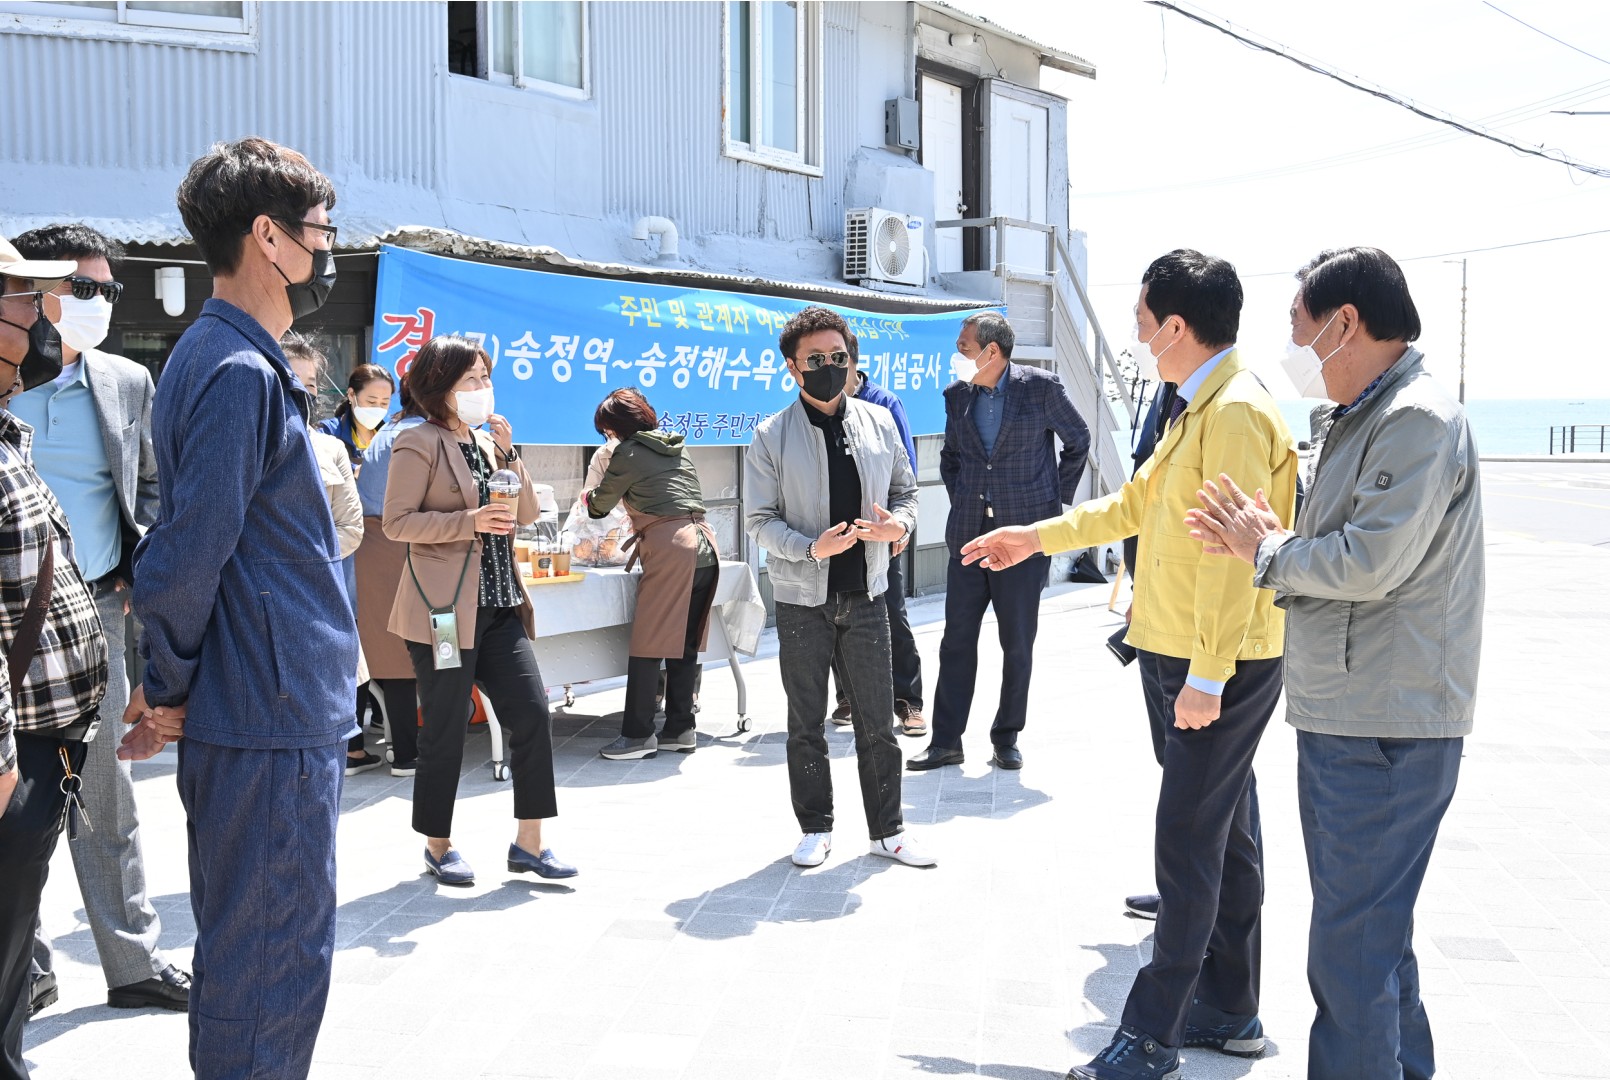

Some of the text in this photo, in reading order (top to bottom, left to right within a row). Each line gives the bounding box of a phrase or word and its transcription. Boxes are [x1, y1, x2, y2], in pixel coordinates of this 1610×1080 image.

[619, 295, 662, 328] 주민
[668, 299, 690, 330] 및
[694, 302, 749, 334] 관계자
[755, 307, 796, 336] 여러
[657, 410, 776, 440] 송정동 주민자
